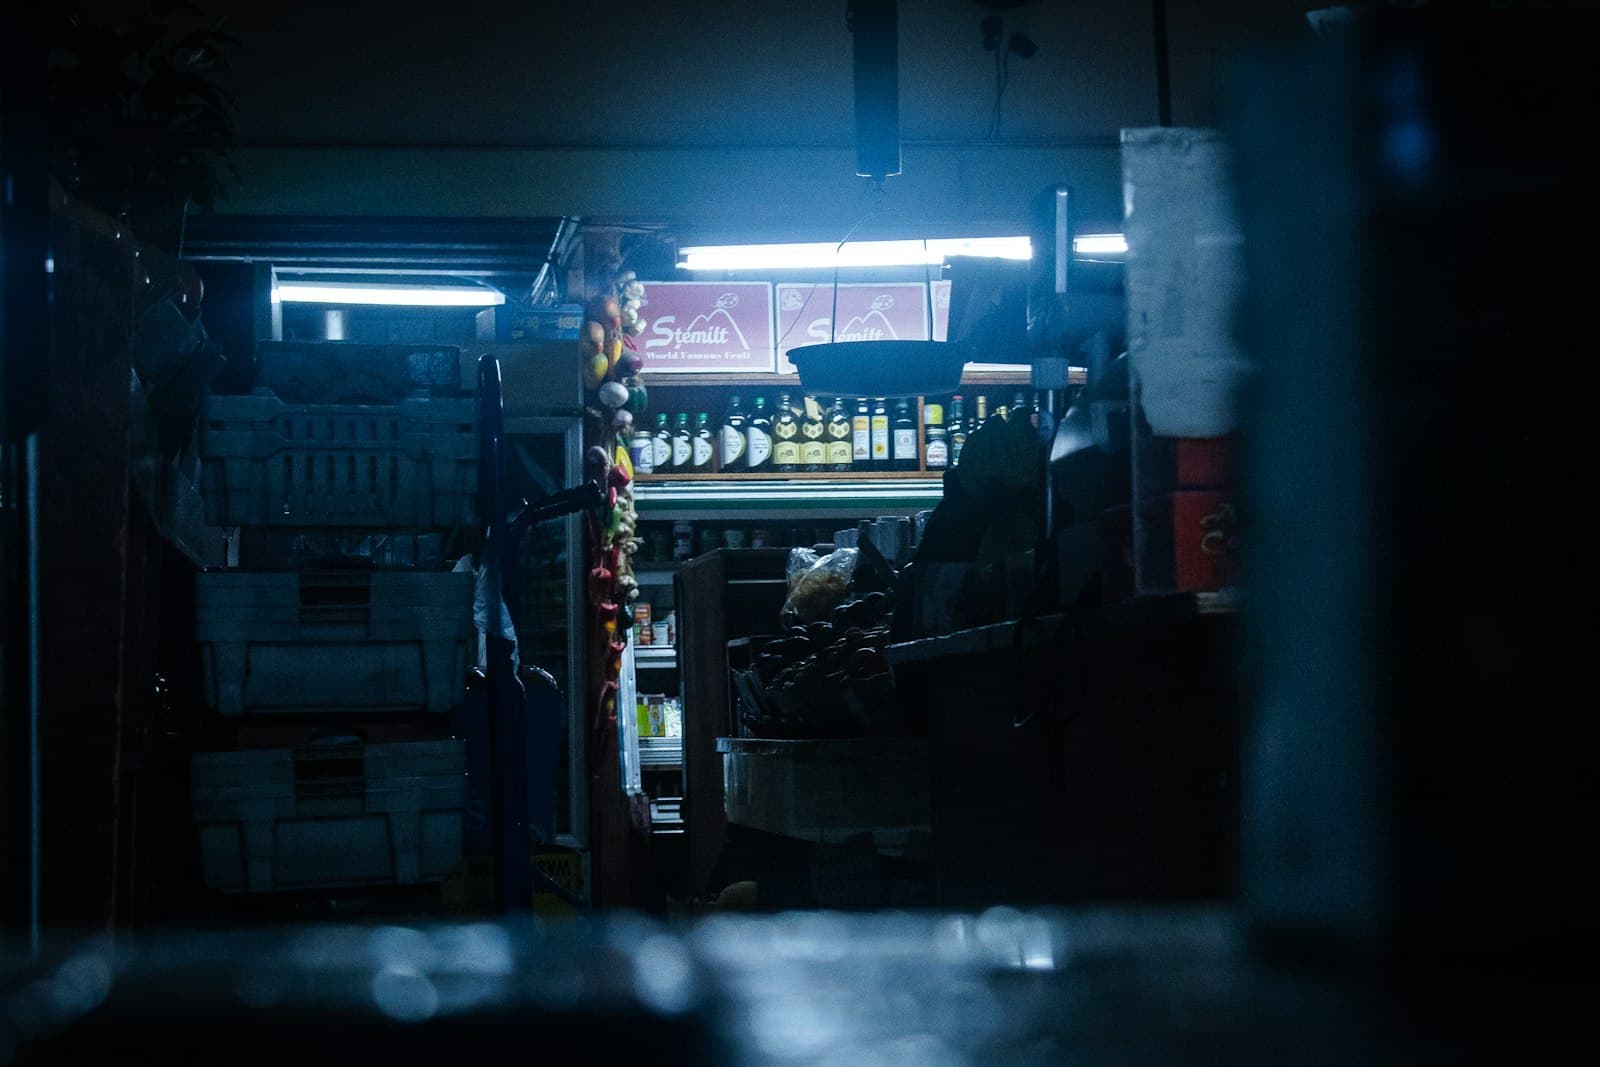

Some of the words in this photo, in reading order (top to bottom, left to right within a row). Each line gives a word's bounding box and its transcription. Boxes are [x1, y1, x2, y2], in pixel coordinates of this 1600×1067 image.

[645, 316, 729, 349] Stemilt
[801, 318, 885, 346] Semilt
[646, 352, 679, 360] World
[681, 352, 722, 360] Famous
[725, 352, 751, 360] Fruit
